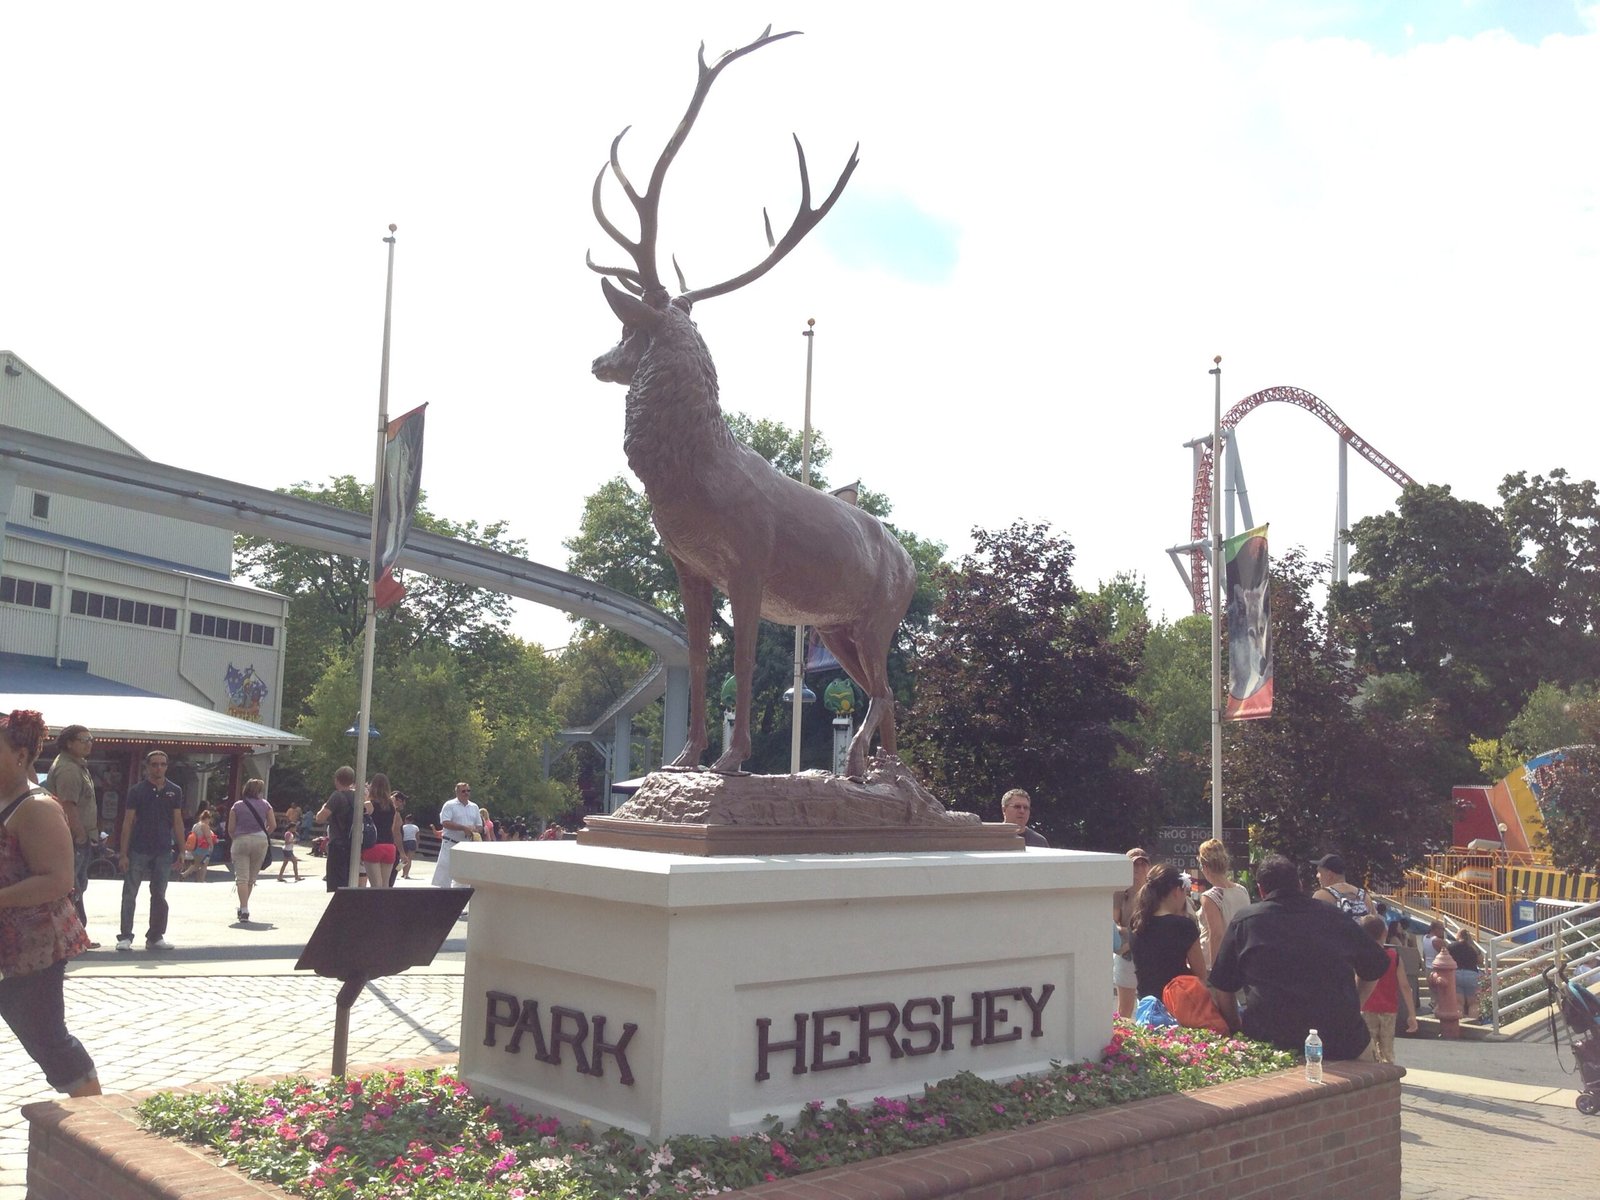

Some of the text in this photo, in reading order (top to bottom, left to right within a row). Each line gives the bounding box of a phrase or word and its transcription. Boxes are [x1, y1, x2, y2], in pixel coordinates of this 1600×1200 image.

[1191, 830, 1231, 840] HOPER
[483, 990, 638, 1086] PARK
[755, 984, 1056, 1082] HERSHEY
